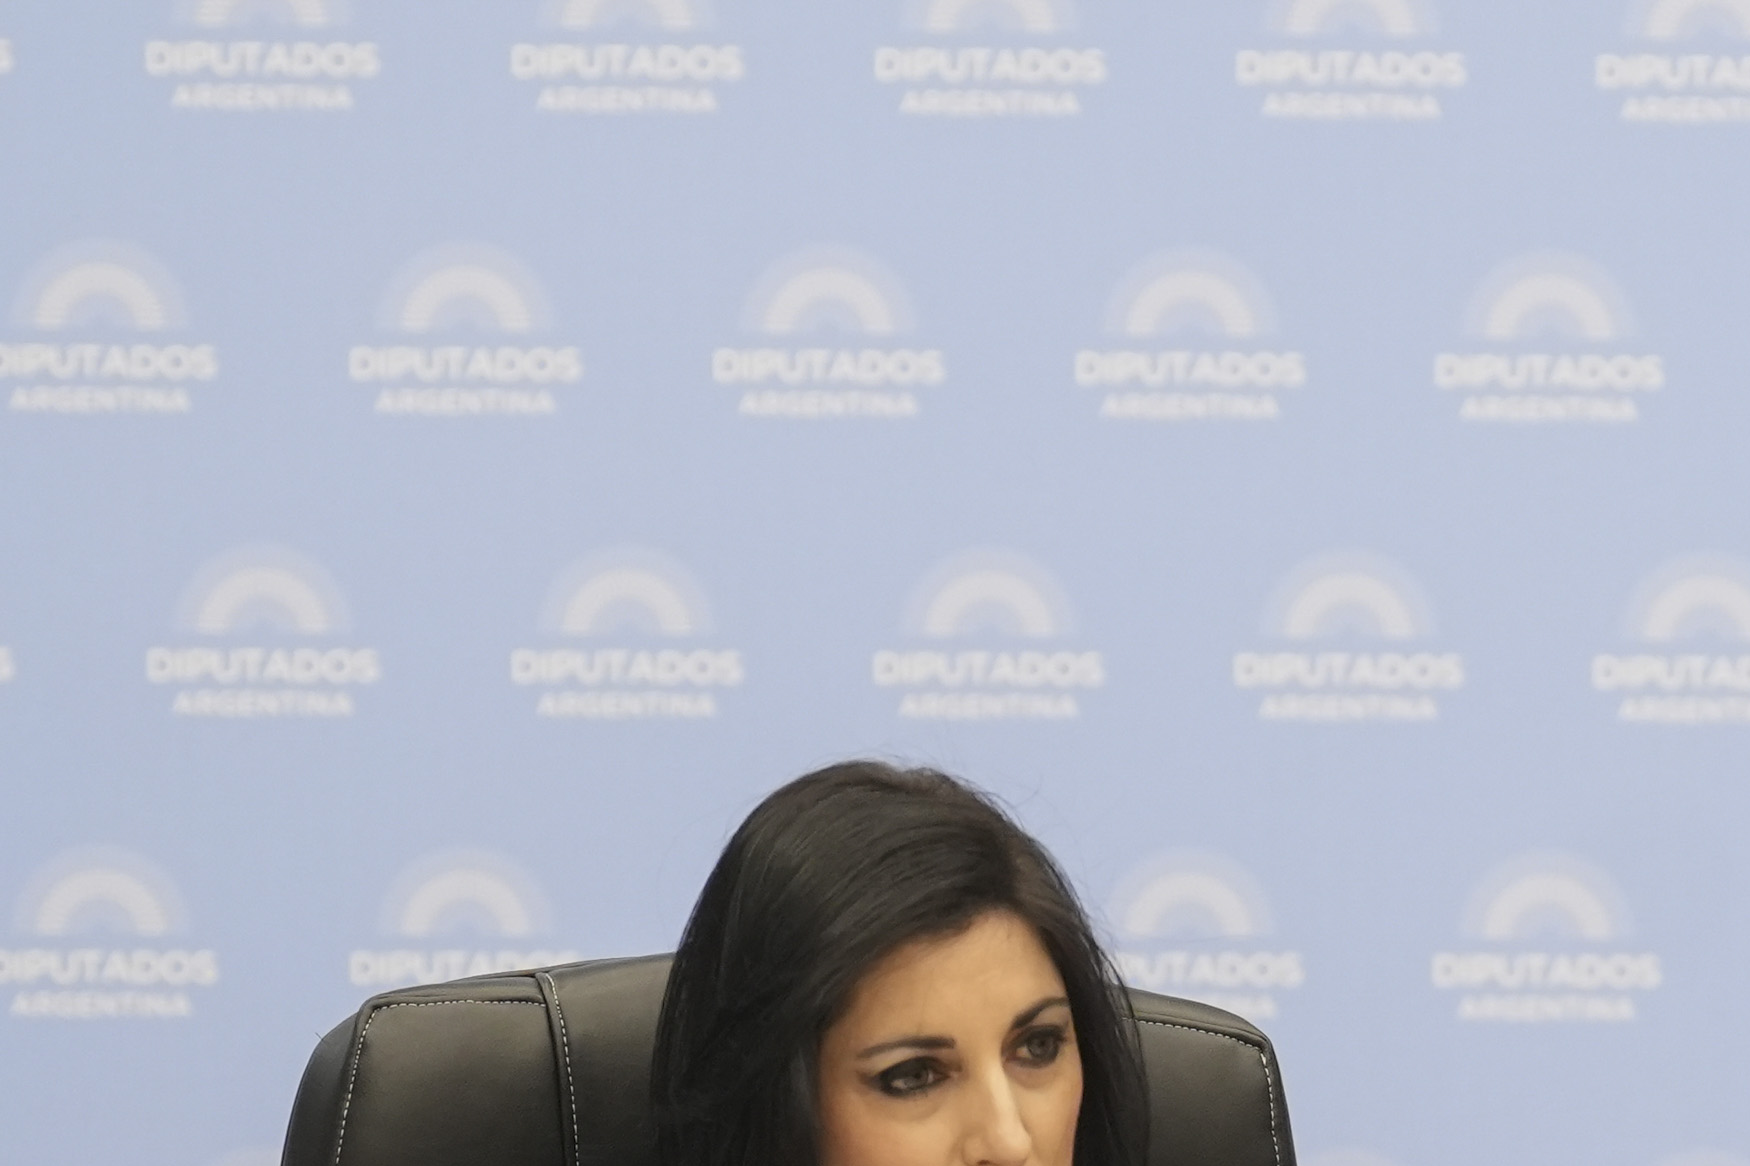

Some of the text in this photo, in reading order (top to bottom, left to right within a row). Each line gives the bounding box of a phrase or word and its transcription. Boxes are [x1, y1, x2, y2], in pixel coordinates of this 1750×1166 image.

[145, 42, 379, 76] DIPUTADOS
[510, 45, 744, 78] DIPUTADOS
[874, 49, 1106, 83] DIPUTADOS
[1236, 52, 1465, 86] DIPUTADOS
[349, 347, 582, 382] DIPUTADOS
[712, 349, 944, 383] DIPUTADOS
[1075, 352, 1305, 386] DIPUTADOS
[1435, 355, 1664, 389] DIPUTADOS
[147, 649, 380, 683] DIPUTADOS
[511, 650, 742, 684] DIPUTADOS
[873, 652, 1104, 686] DIPUTADOS
[1233, 654, 1464, 688] DIPUTADOS
[1431, 954, 1661, 988] DIPUTADOS
